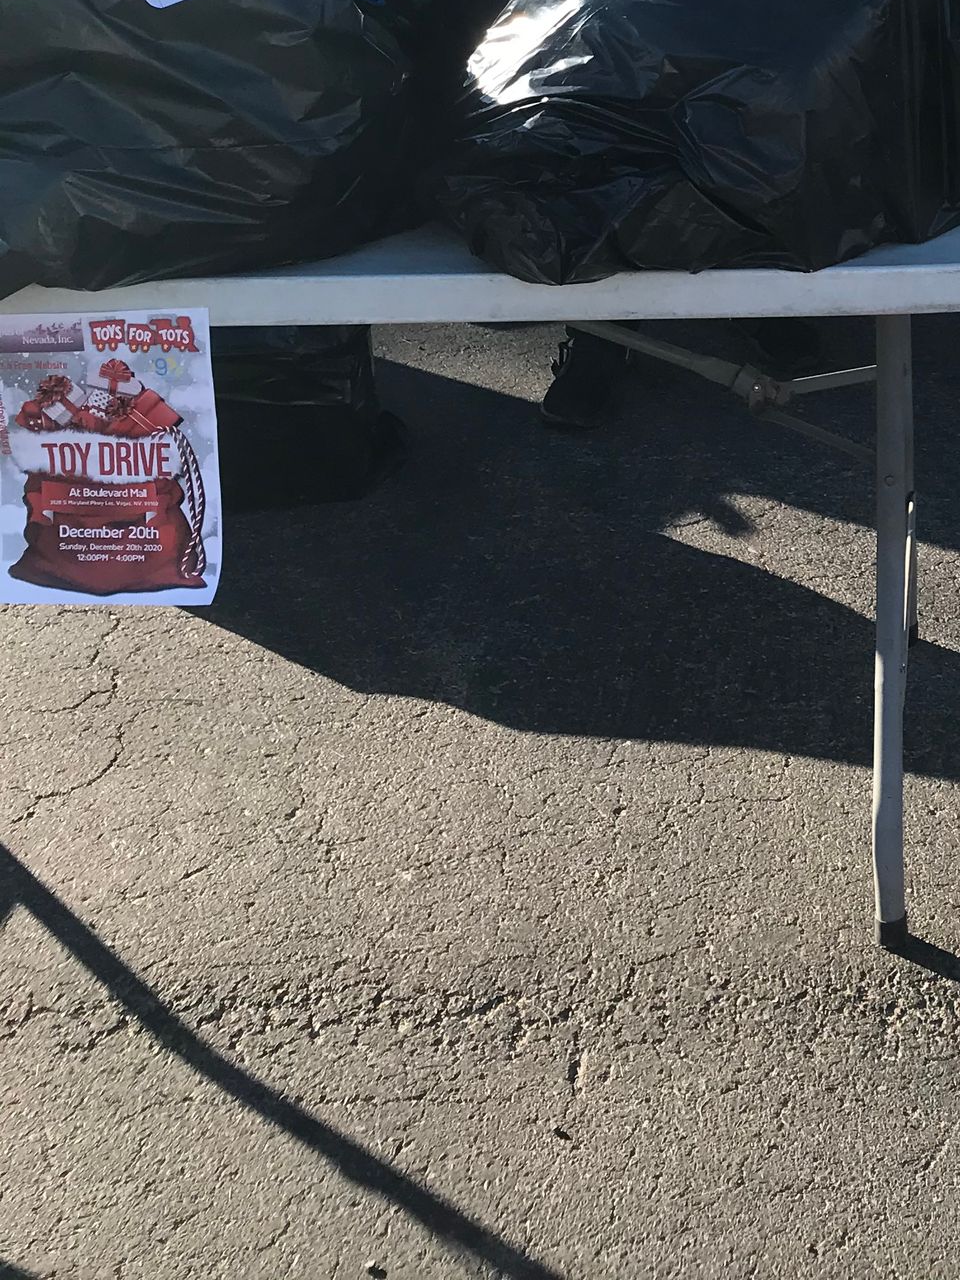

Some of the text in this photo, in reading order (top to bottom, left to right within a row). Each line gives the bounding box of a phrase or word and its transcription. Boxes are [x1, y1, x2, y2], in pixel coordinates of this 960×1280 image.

[22, 334, 58, 345] Nevada,
[58, 334, 75, 344] Inc.
[93, 323, 190, 345] TOYS FOR TOTS
[41, 441, 173, 478] TOY DRIVE
[69, 487, 148, 498] At Boulevard Mall
[58, 524, 160, 540] December 20th
[58, 542, 163, 553] Sunday, December 20th 2020
[76, 553, 109, 562] 12:00PM
[115, 554, 145, 562] 4:00PM
